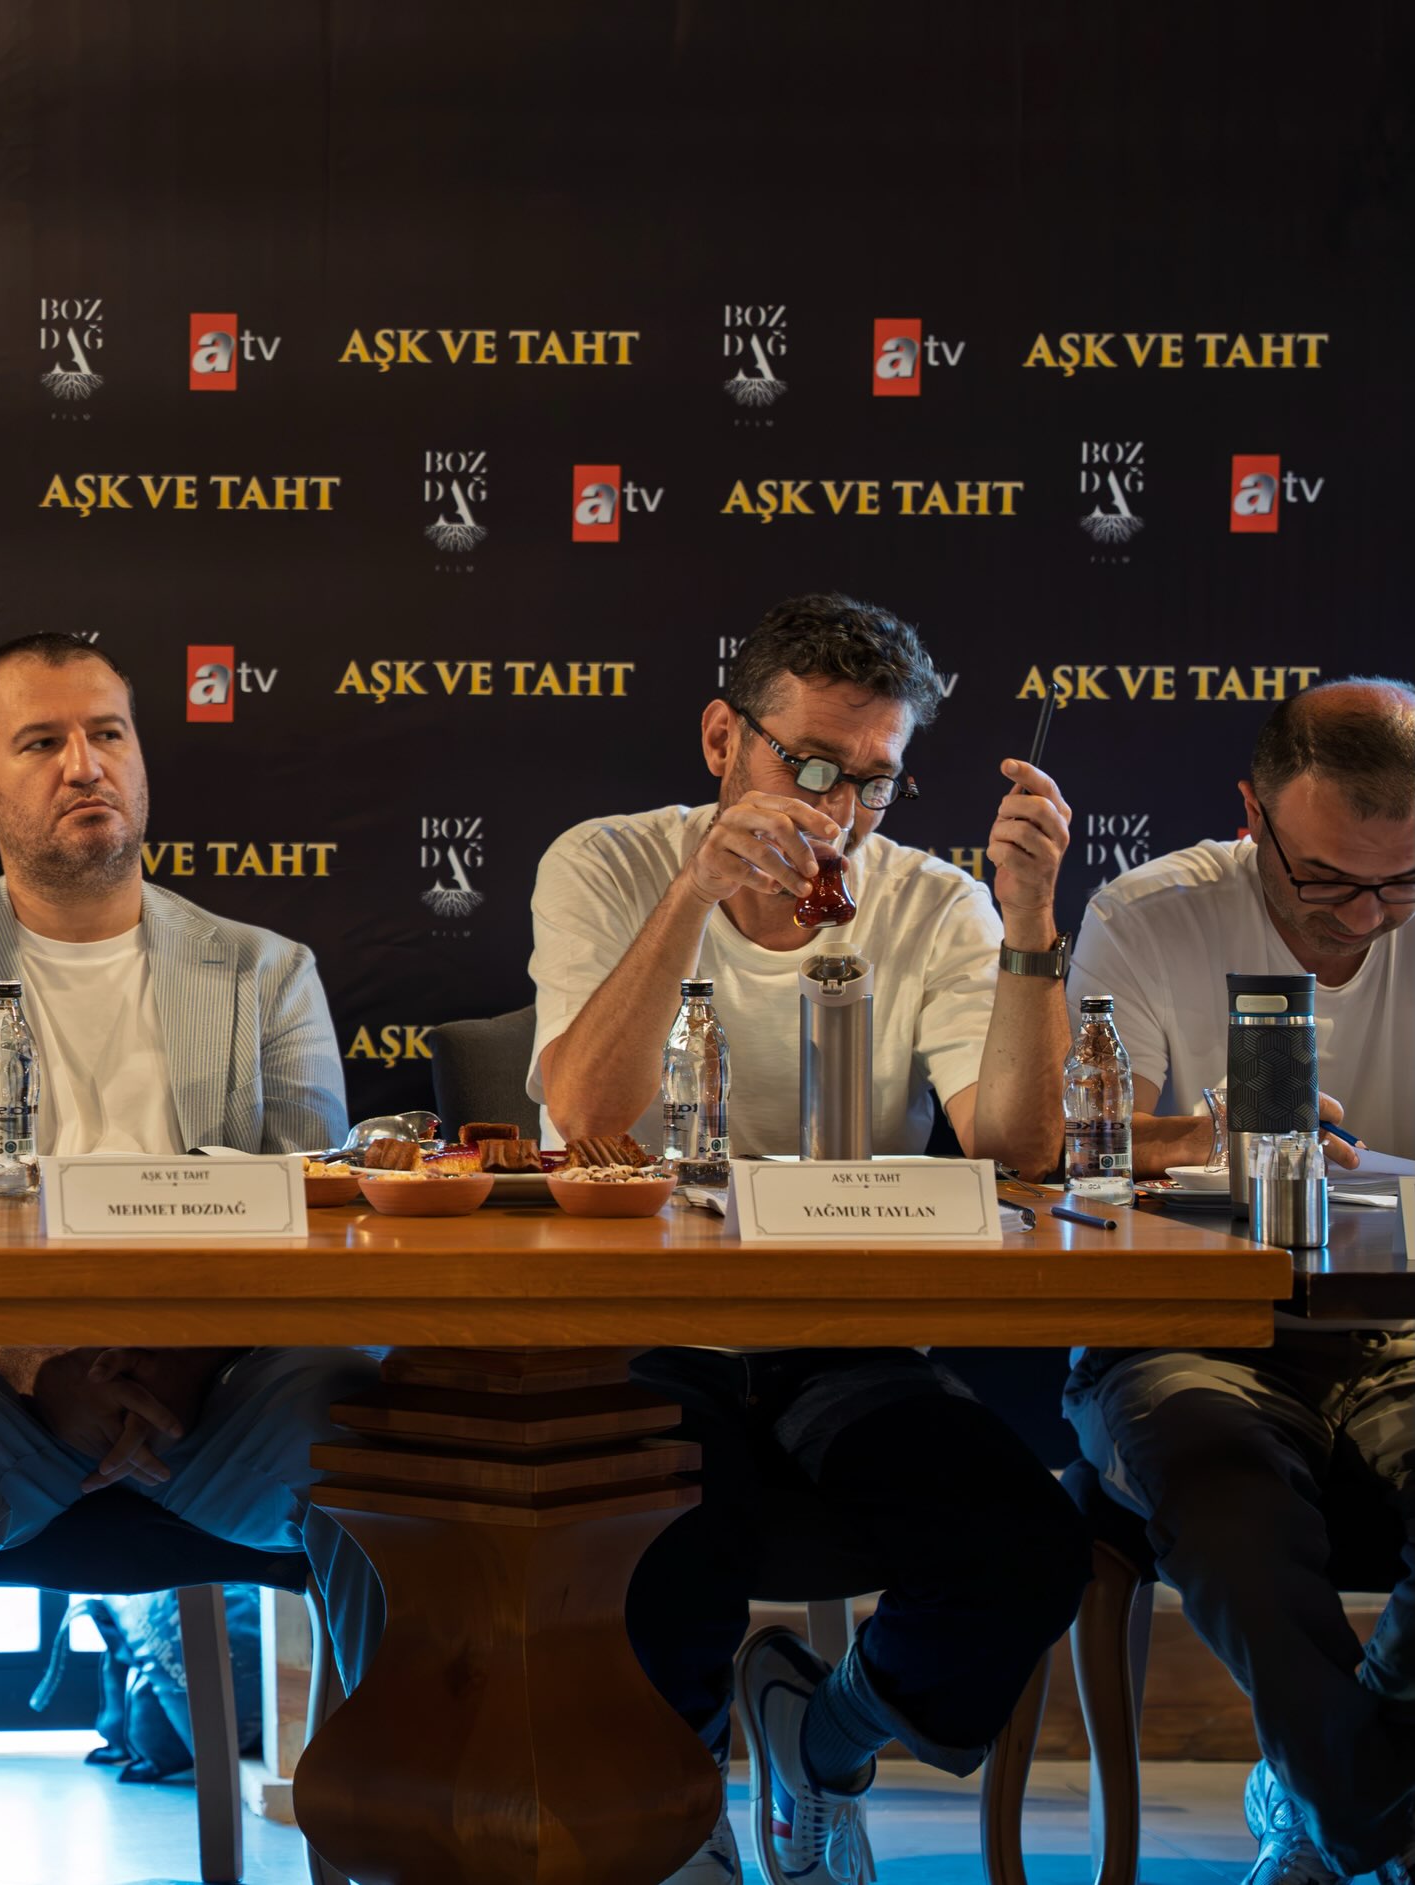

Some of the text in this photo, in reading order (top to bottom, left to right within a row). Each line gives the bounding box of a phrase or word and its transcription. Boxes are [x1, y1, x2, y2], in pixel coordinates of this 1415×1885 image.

[41, 298, 102, 320] BOZ
[725, 305, 786, 327] BOZ
[191, 330, 281, 374] atv
[338, 329, 640, 372] AŞK VE TAHT
[876, 335, 965, 379] atv
[1023, 333, 1328, 377] AŞK VE TAHT
[426, 451, 486, 473] BOZ
[1082, 442, 1143, 464] BOZ
[39, 474, 341, 517] AŞK VE TAHT
[575, 482, 663, 525] atv
[721, 480, 1024, 523] AŞK VE TAHT
[1233, 472, 1324, 516] atv
[189, 662, 277, 705] atv
[335, 660, 634, 704] AŞK VE TAHT
[1016, 665, 1321, 709] AŞK VE TAHT
[422, 817, 482, 839] BOZ
[1088, 815, 1149, 837] BOZ
[140, 842, 338, 877] VE TAHT
[344, 1025, 436, 1069] AŞK
[166, 1171, 179, 1180] VE
[183, 1171, 210, 1180] TAHT
[832, 1173, 901, 1184] AŞK VE TAHT
[108, 1201, 246, 1216] MEHMET BOZDAĞ
[803, 1203, 936, 1217] YAĞMUR TAYLAN
